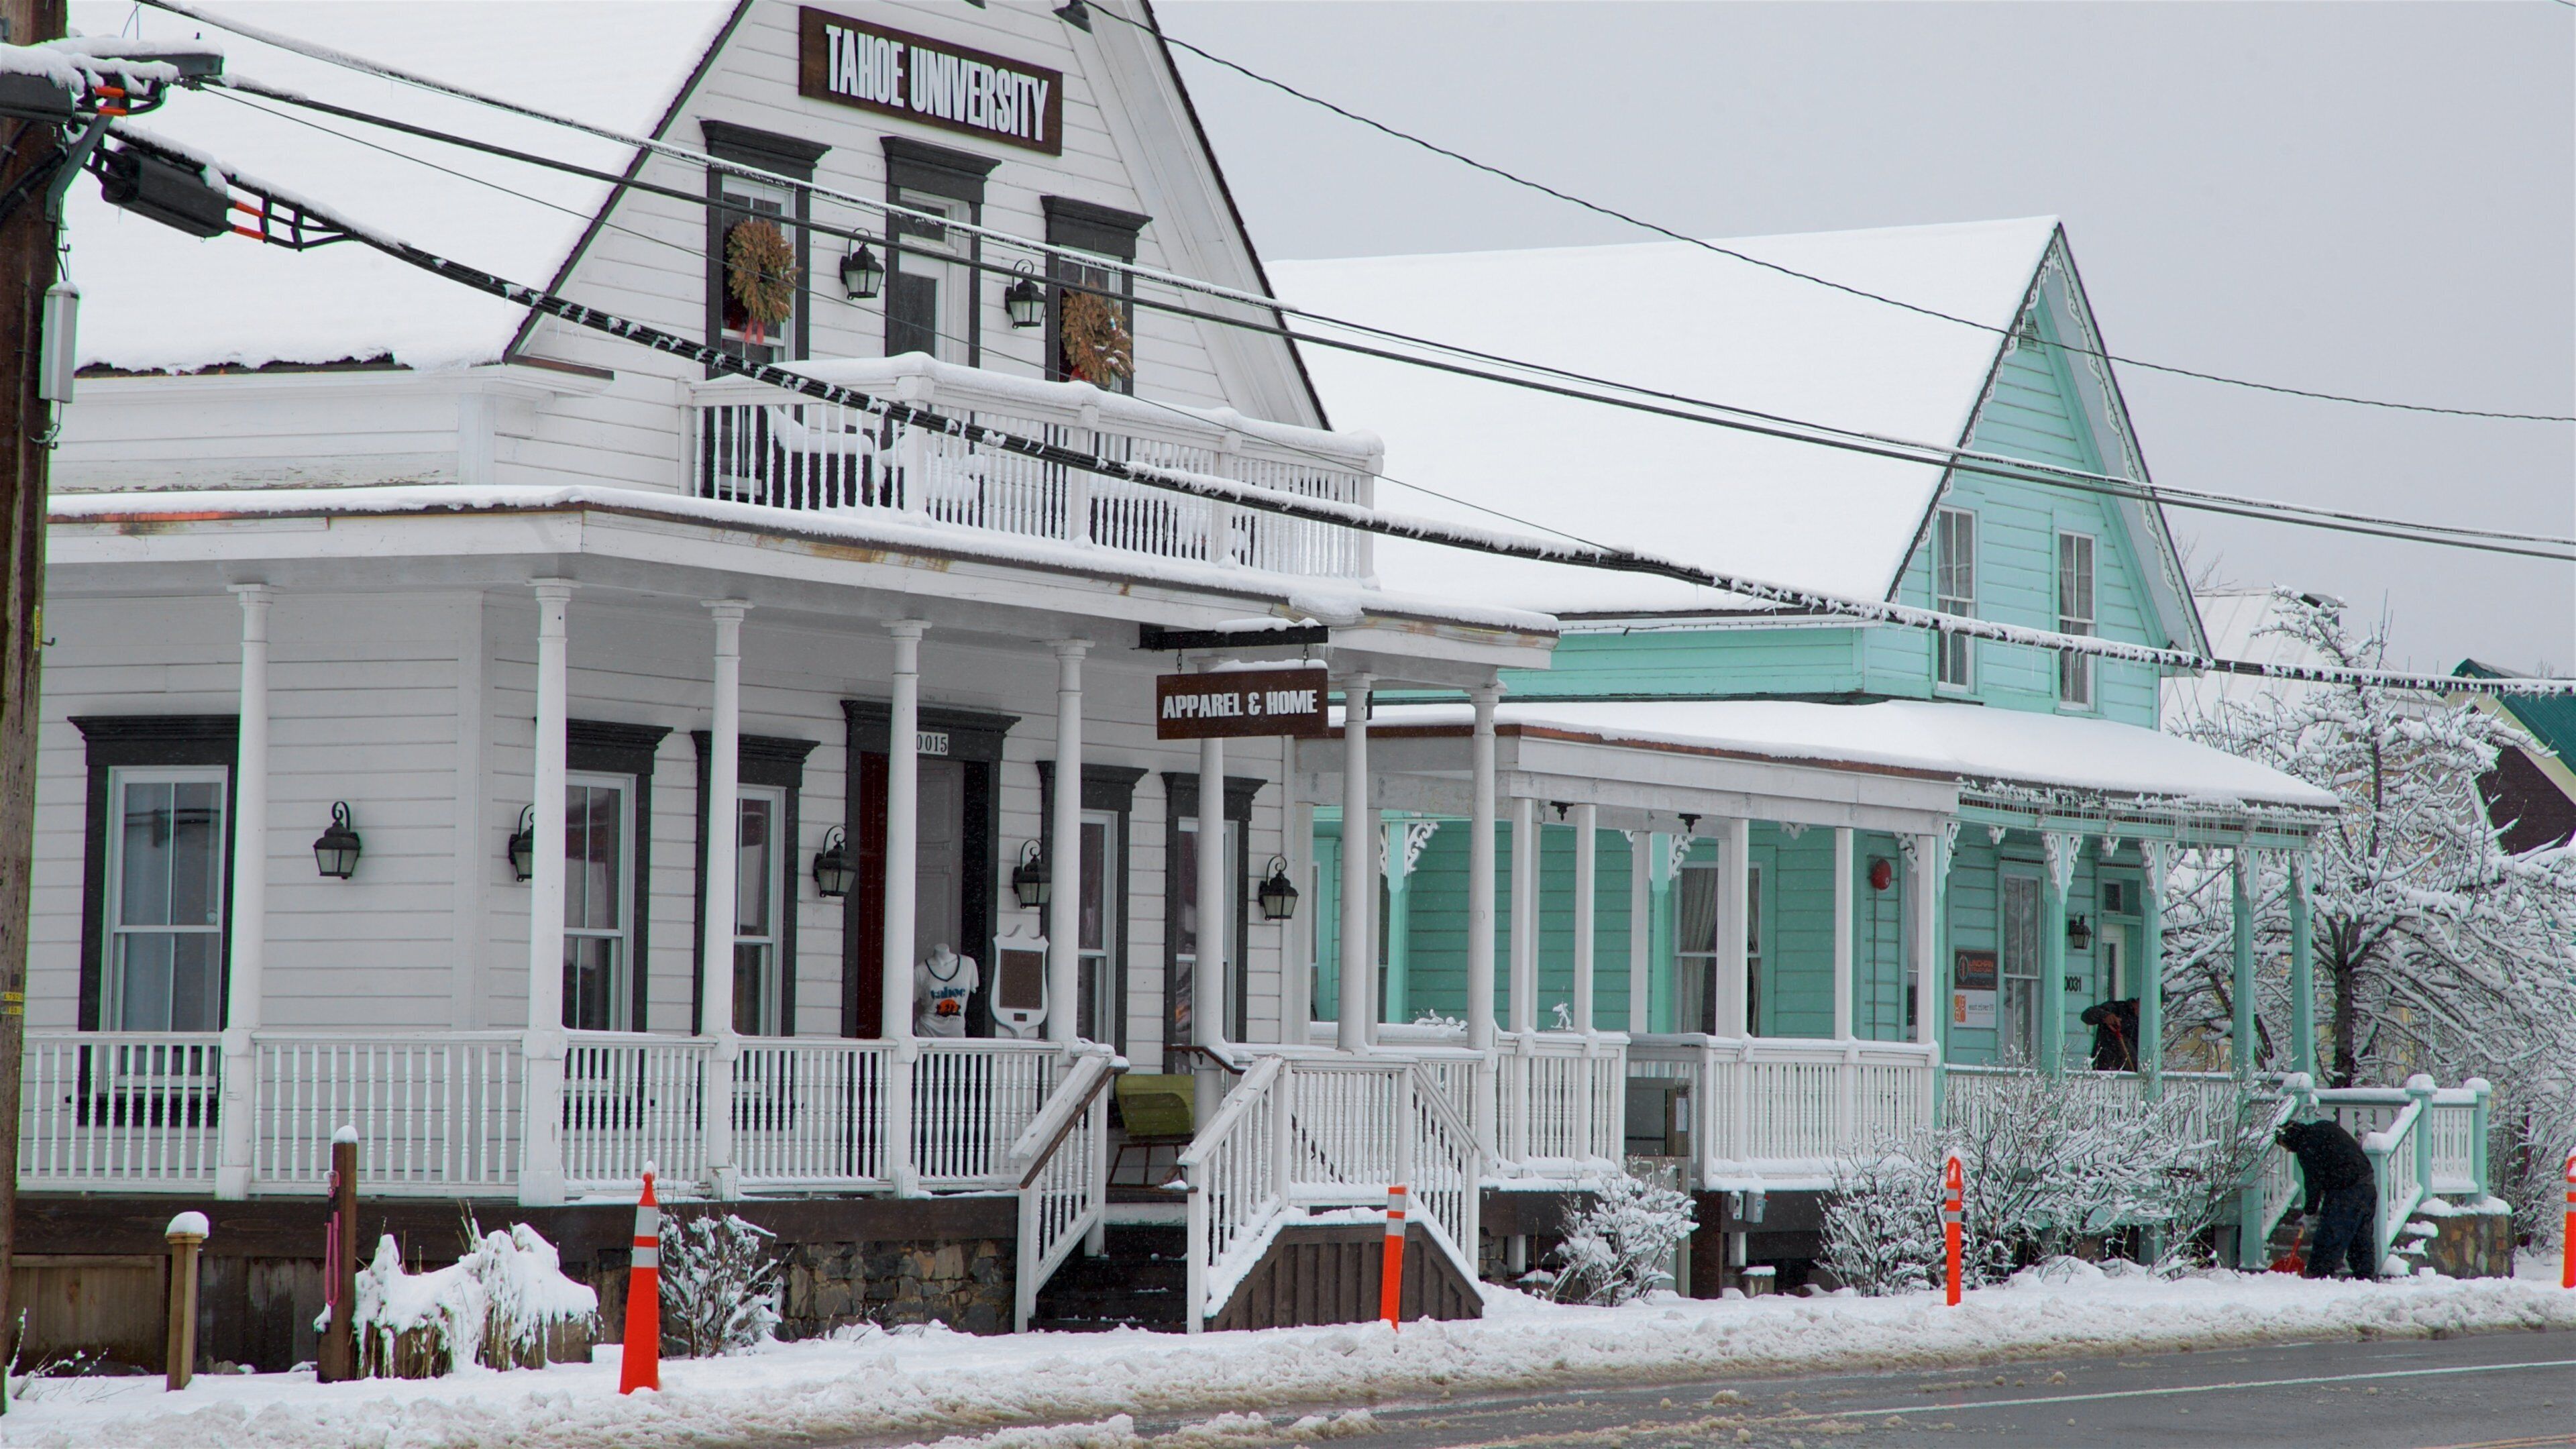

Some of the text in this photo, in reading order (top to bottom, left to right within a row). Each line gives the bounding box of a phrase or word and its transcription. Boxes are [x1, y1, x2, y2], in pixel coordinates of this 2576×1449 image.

[826, 24, 1049, 142] TAHOE UNIVERSITY
[1162, 690, 1318, 719] APPAREL & HOME
[916, 734, 947, 753] 0015
